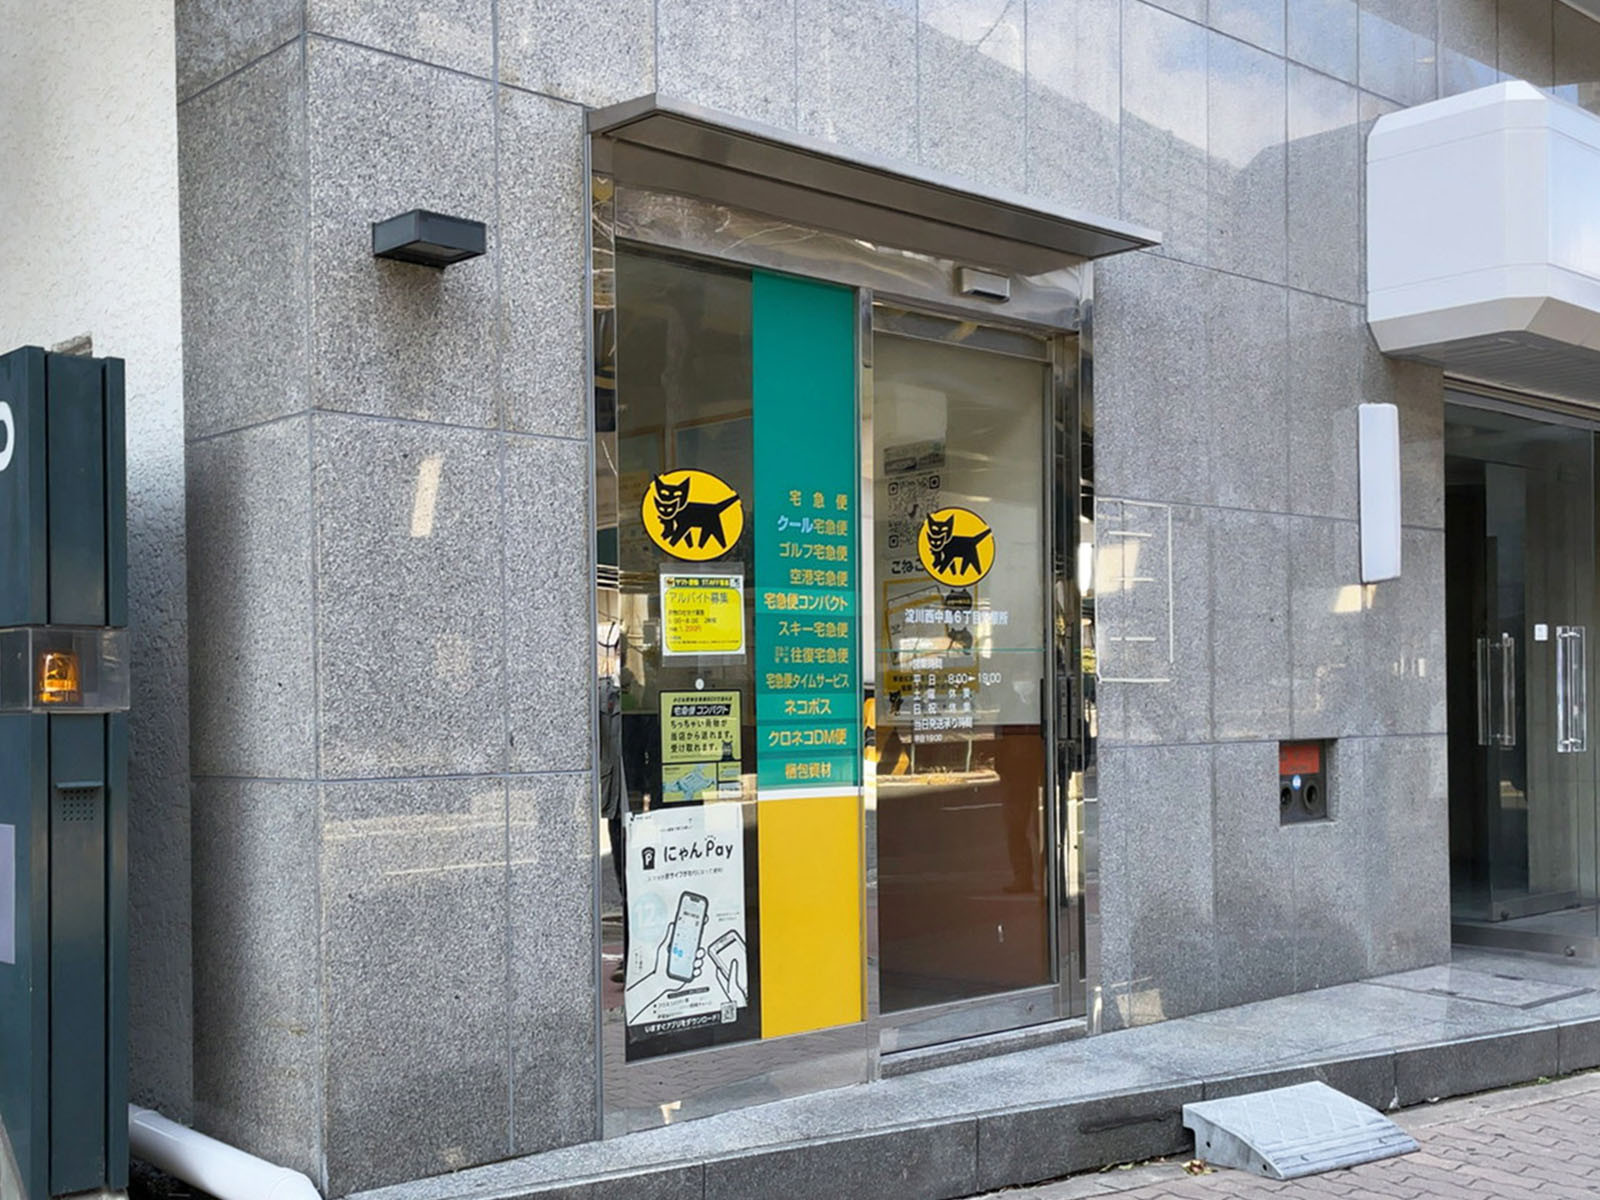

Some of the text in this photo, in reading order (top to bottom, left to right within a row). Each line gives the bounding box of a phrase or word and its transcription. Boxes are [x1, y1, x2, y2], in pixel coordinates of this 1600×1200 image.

[777, 514, 848, 536] クール宅急便
[779, 541, 848, 562] ゴルフ宅急便
[790, 568, 848, 587] 空港宅急便
[764, 592, 848, 611] 宅急便コンパクト
[778, 620, 848, 638] スキー宅急便
[766, 672, 850, 690] 宅急便タイムサービス
[673, 705, 730, 716] 宅急便コンパクト
[785, 698, 832, 715] ネコポス
[768, 728, 847, 747] クロネコDM便
[785, 761, 832, 780] 梱包資材
